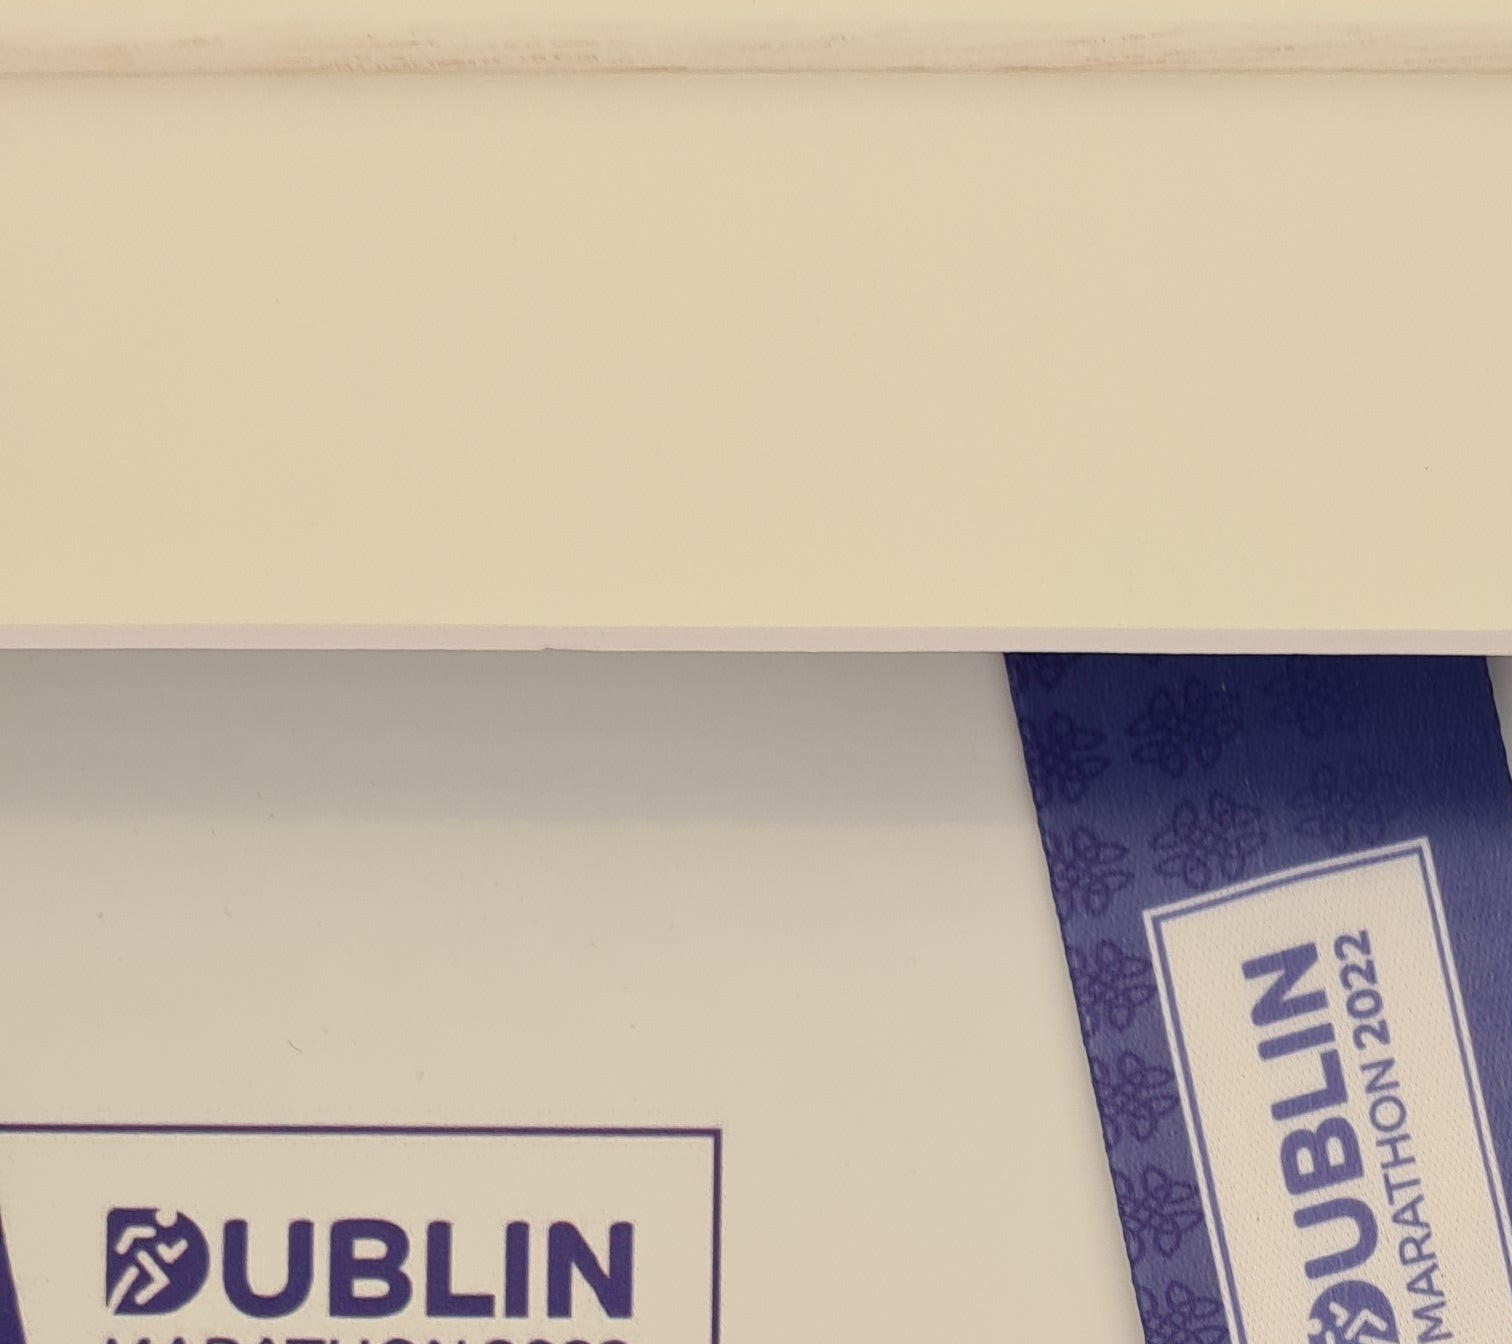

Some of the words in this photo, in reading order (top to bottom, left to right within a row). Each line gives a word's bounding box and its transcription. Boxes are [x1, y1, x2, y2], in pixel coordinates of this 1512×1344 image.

[1333, 928, 1391, 1051] 2022
[1360, 1056, 1454, 1344] MARATHON
[106, 1207, 634, 1319] DUBLIN
